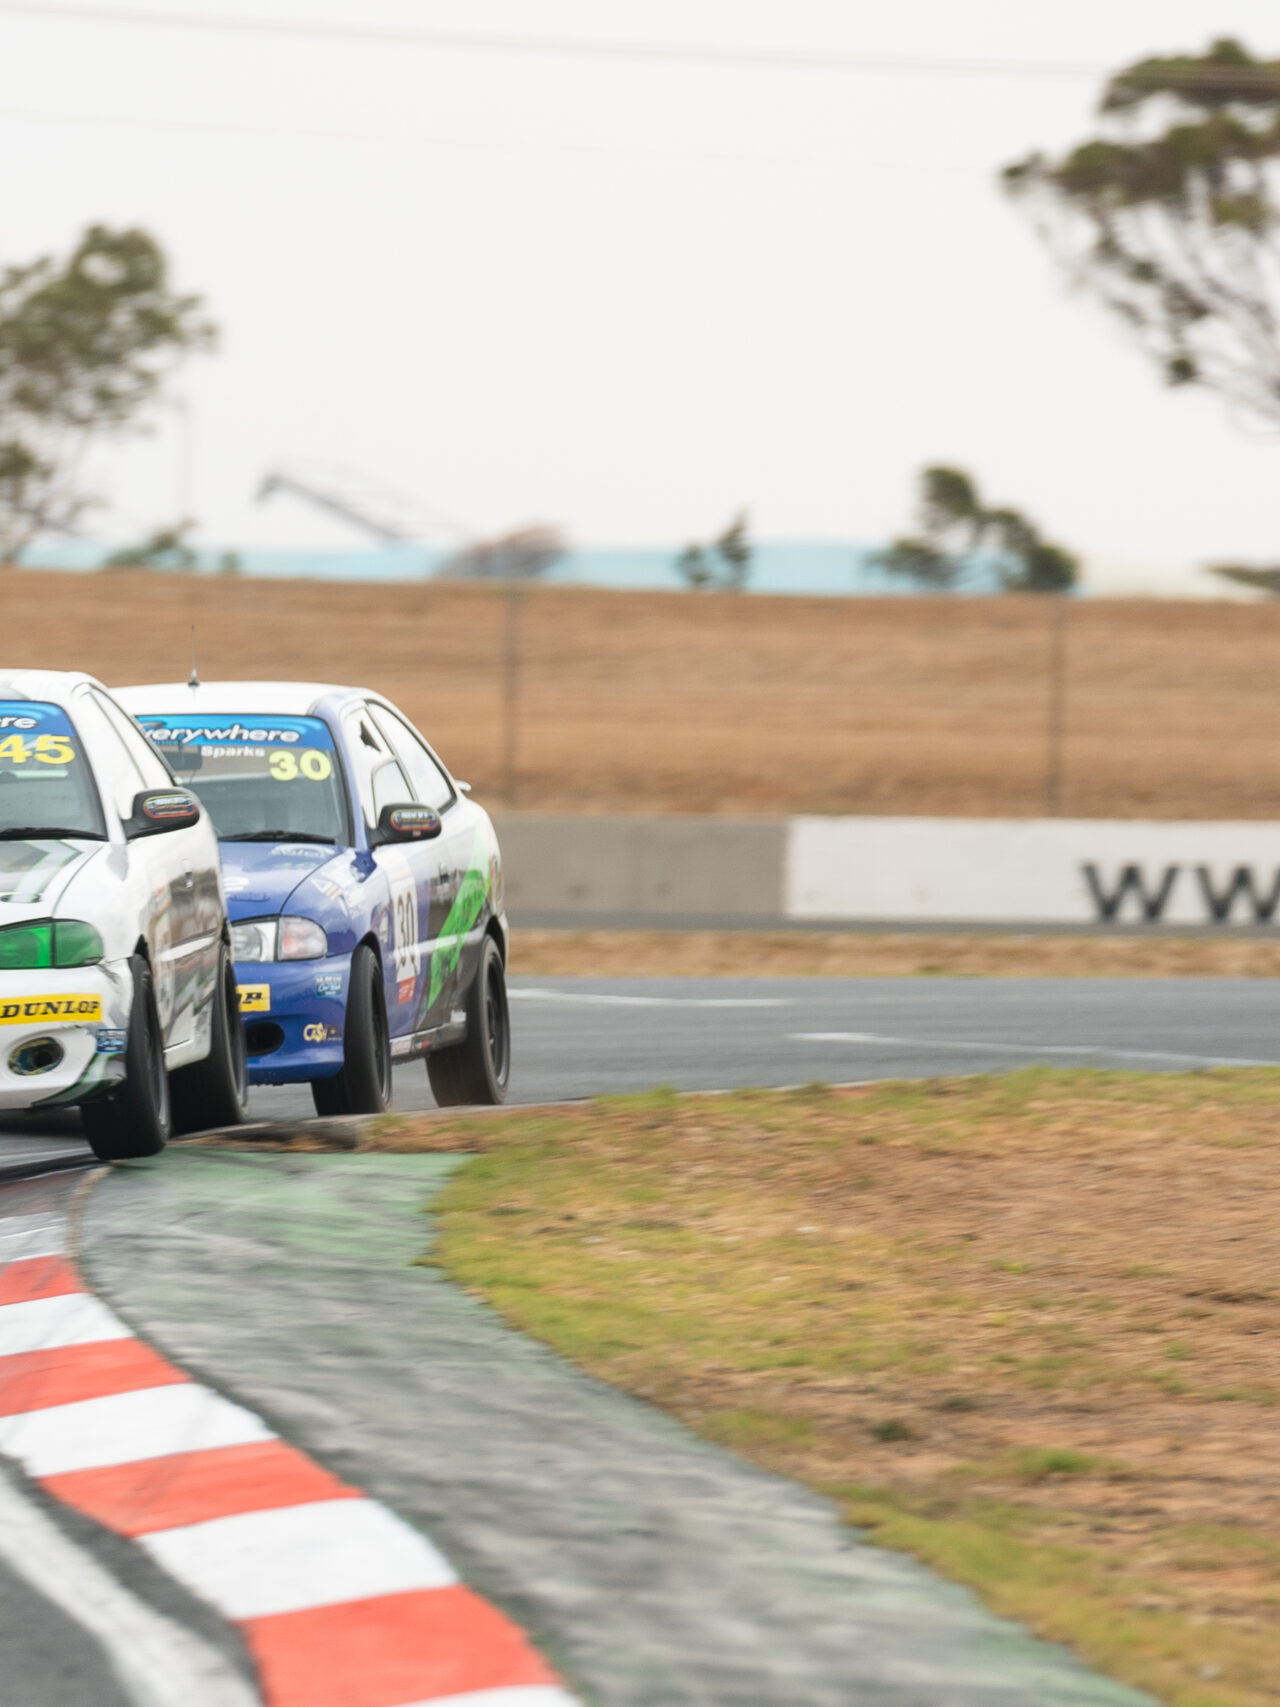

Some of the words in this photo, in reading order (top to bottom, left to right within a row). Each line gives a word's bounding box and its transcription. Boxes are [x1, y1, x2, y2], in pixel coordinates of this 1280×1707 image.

[145, 724, 300, 743] verywhere
[201, 745, 265, 758] Sparks
[269, 749, 331, 782] 30
[0, 1001, 100, 1019] DUNLOP
